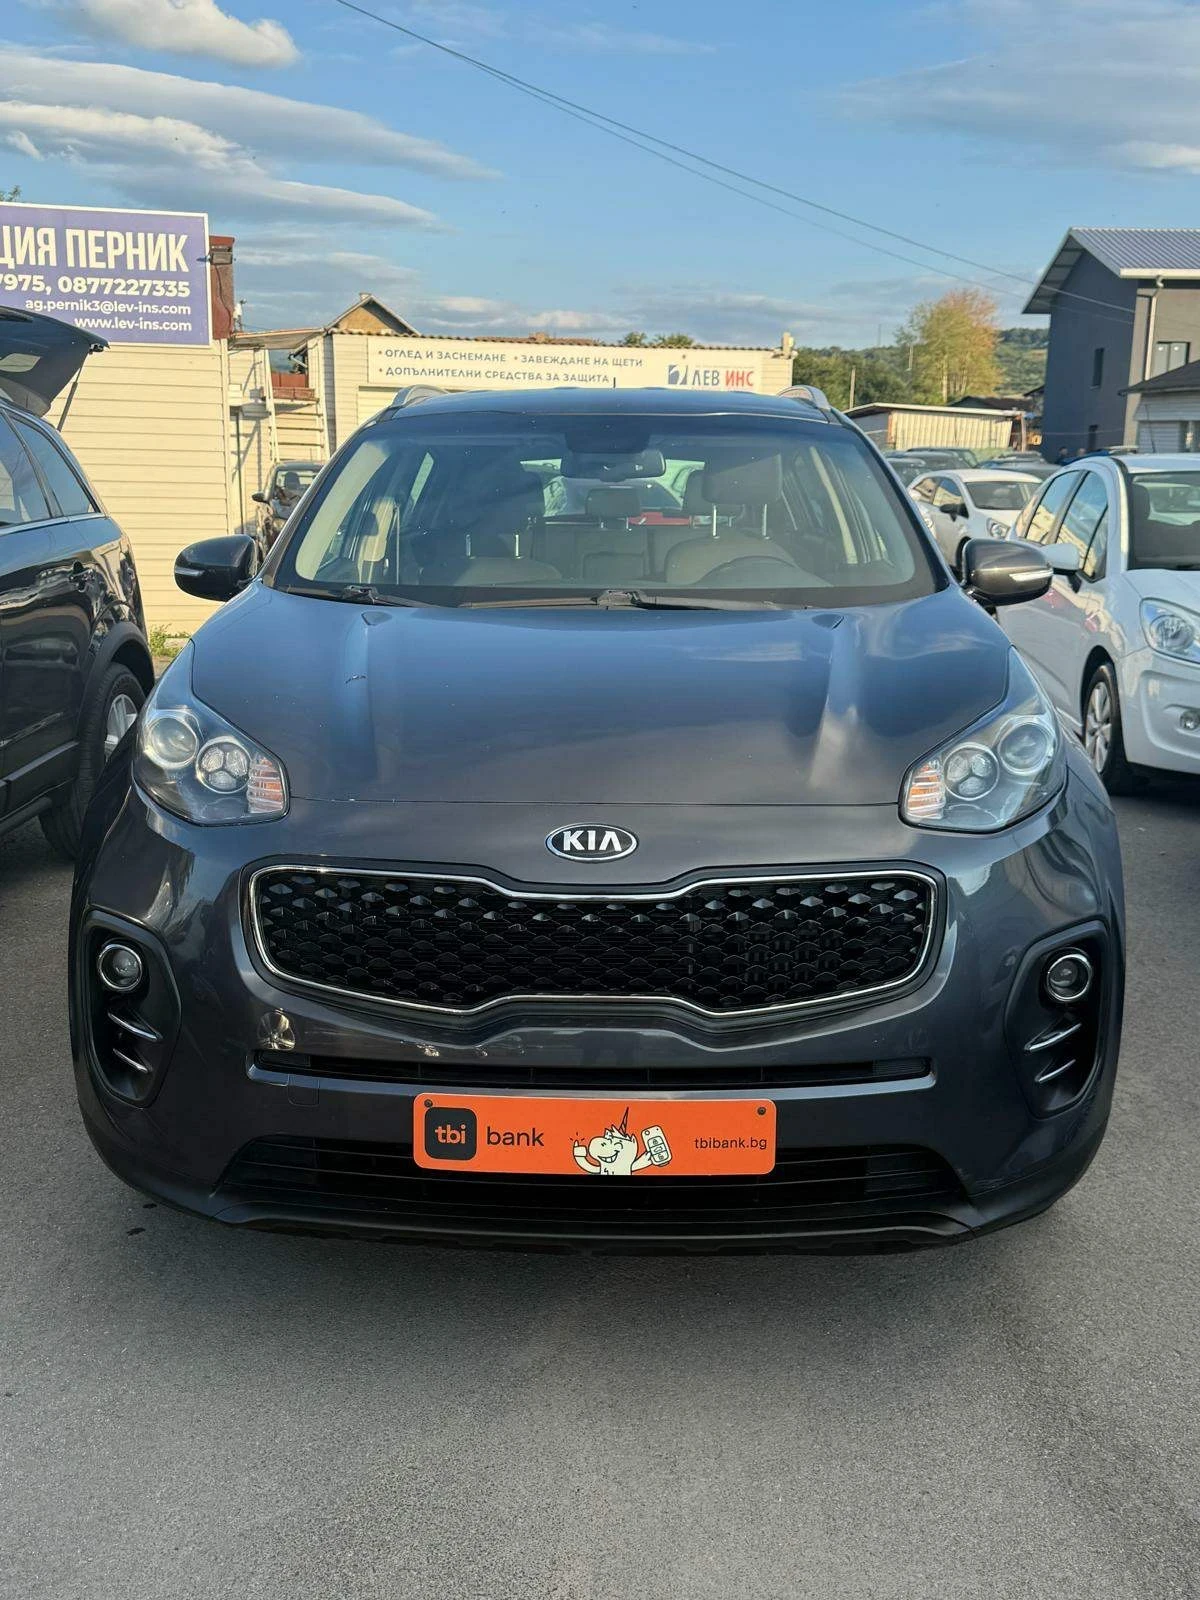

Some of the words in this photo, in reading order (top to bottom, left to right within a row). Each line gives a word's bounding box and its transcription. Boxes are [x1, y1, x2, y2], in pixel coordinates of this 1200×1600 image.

[65, 228, 190, 273] ПЕРНИК
[0, 273, 52, 296] 975,
[58, 275, 191, 298] 0877227335
[25, 299, 191, 315] ag.pernik3@lev-ins.com
[74, 316, 192, 332] www.lev-ins.com
[385, 349, 422, 360] ОГЛЕД
[425, 350, 434, 360] И
[437, 351, 507, 363] ЗАСНЕМАНЕ
[520, 354, 591, 366] ЗАВЕЖДАНЕ
[593, 356, 609, 367] НА
[611, 357, 643, 368] ЩЕТИ
[385, 366, 482, 379] ДОПЪЛНИТЕЛНИ
[485, 370, 543, 382] СРЕДСТВА
[546, 372, 560, 383] ЗА
[563, 373, 610, 384] ЗАЩИТА
[692, 370, 720, 387] ЛЕВ
[725, 370, 755, 388] ИНС
[562, 830, 622, 852] KIA
[435, 1123, 466, 1146] tbi
[486, 1125, 545, 1148] bank
[694, 1136, 768, 1151] tbibank.bg
